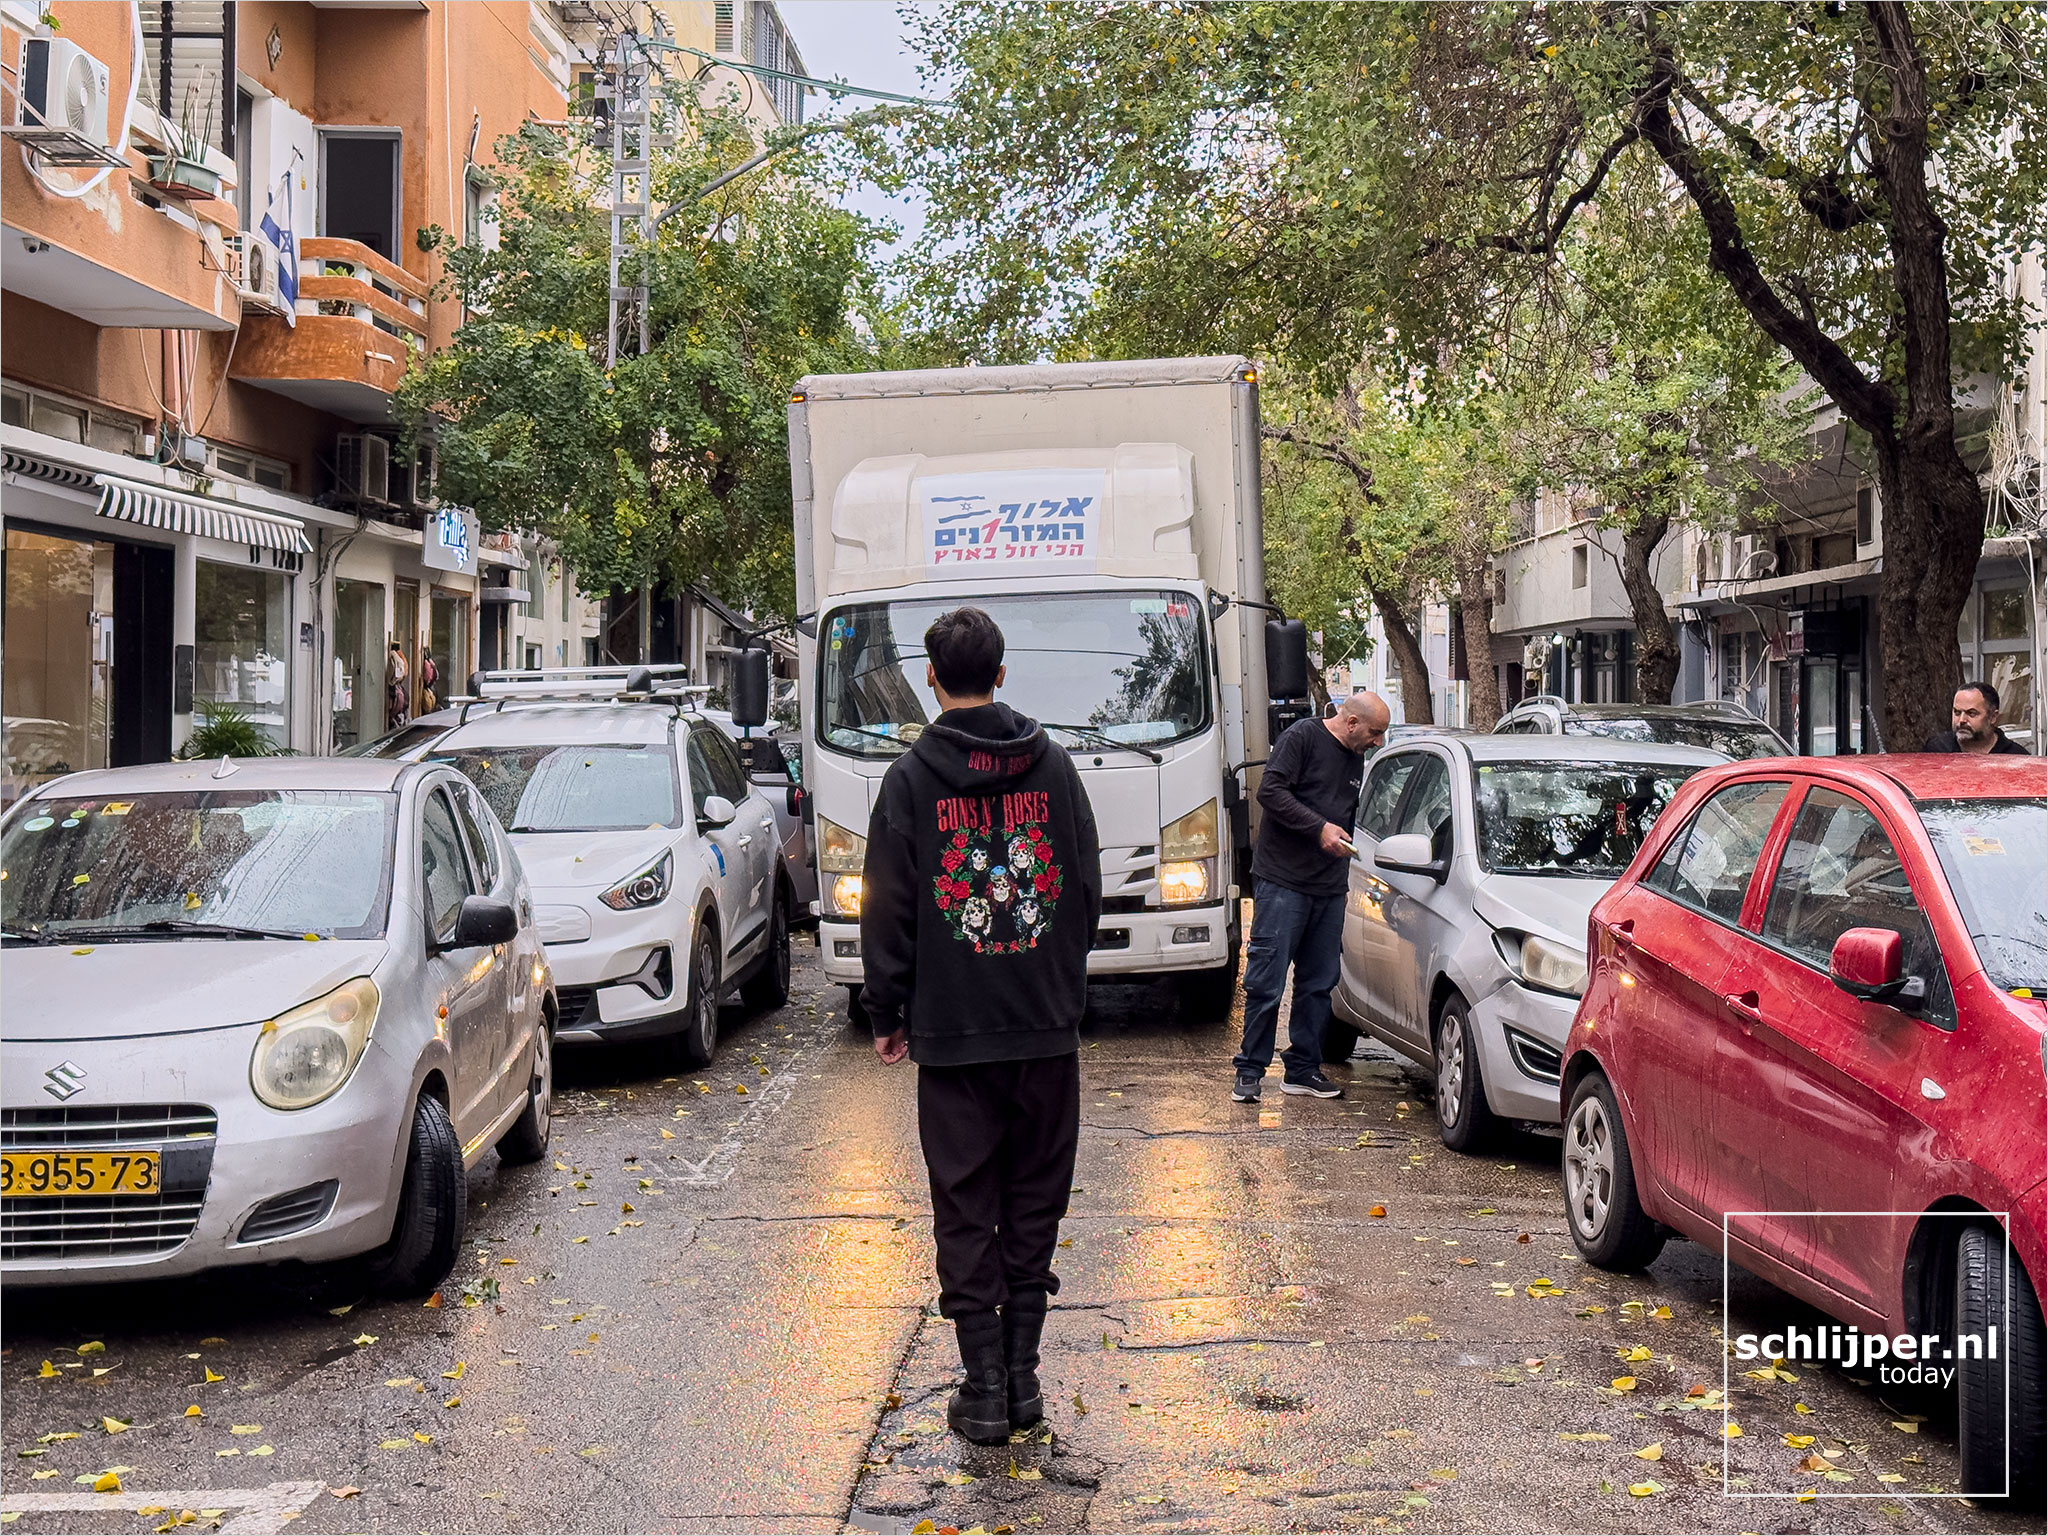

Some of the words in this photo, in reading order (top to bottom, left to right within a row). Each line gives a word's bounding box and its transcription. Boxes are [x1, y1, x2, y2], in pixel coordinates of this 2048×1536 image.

[998, 497, 1094, 524] אלוף
[935, 547, 997, 565] בארץ
[1005, 544, 1039, 559] זול
[1047, 544, 1084, 557] הכי
[936, 797, 979, 832] GUNS
[1002, 791, 1049, 833] ROSES
